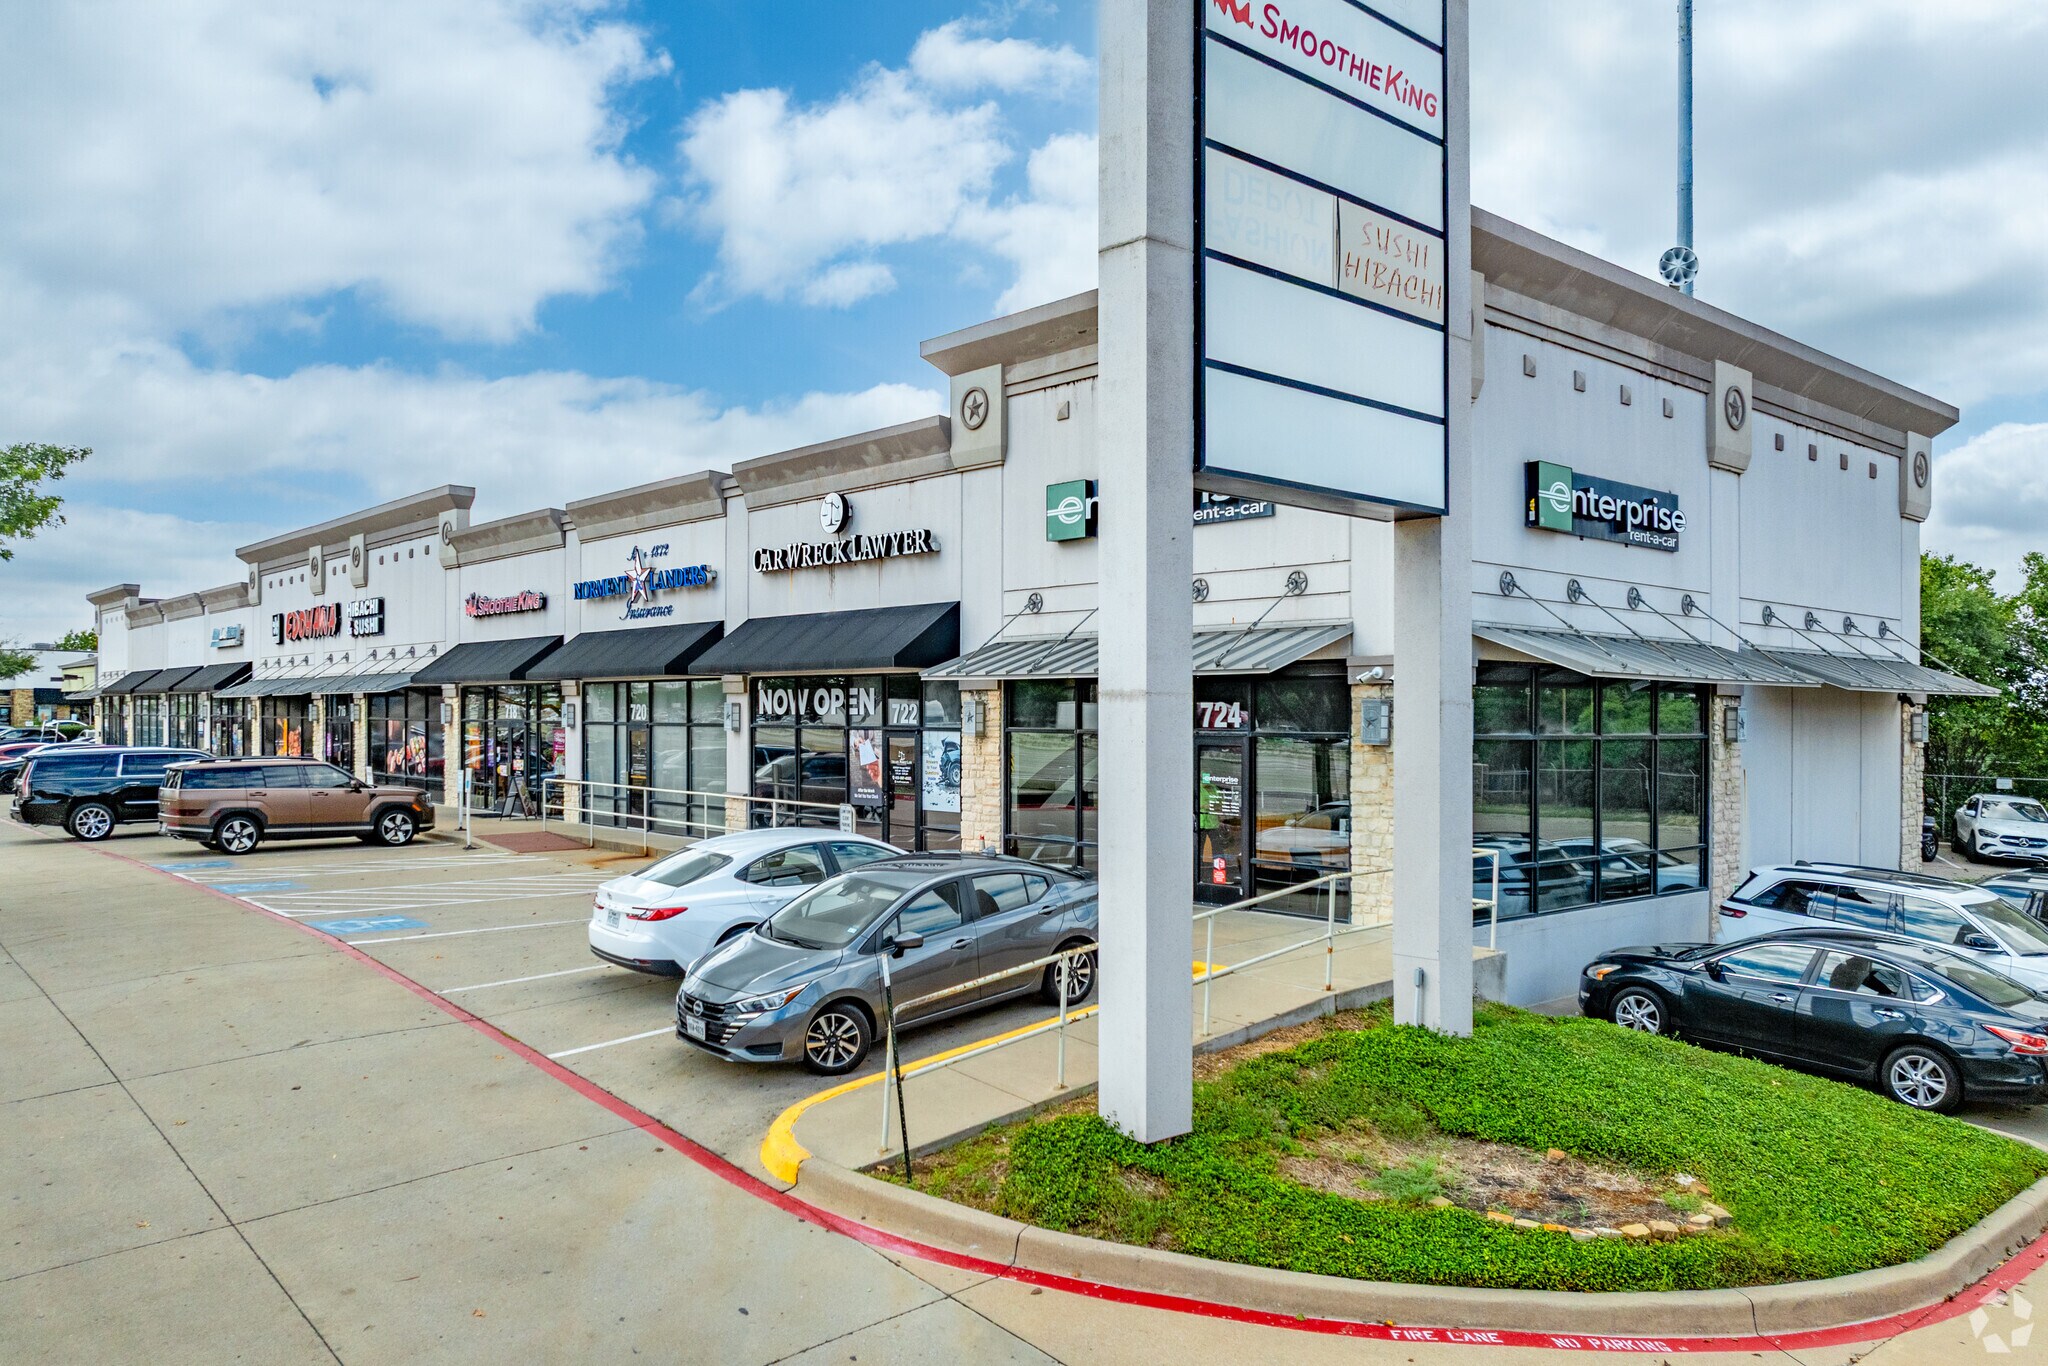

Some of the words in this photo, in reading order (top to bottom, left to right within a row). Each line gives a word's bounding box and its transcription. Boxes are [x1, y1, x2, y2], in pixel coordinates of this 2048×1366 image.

[1260, 4, 1383, 91] SMOOTHIE
[1362, 222, 1428, 268] SUSHI
[1345, 252, 1442, 310] HIBACHI
[1193, 500, 1267, 521] ent-a-car
[1539, 481, 1687, 533] enterprise
[1629, 529, 1677, 548] rent-a-car
[752, 548, 785, 573] CAR
[786, 540, 848, 569] WRECK
[849, 529, 931, 561] LAWYER
[573, 576, 629, 600] NORMENT
[649, 565, 708, 591] LANDERS
[346, 598, 380, 618] HIBACHI
[618, 600, 674, 620] Insurance
[354, 617, 379, 635] SUSHI
[758, 688, 809, 715] NOW
[813, 687, 876, 715] OPEN
[630, 704, 647, 720] 720
[892, 703, 918, 724] 722
[1200, 701, 1242, 728] 724
[1390, 1329, 1439, 1341] FIRE
[1447, 1331, 1504, 1343] LANE
[1552, 1337, 1579, 1349] NO
[1591, 1338, 1673, 1352] PARKING
